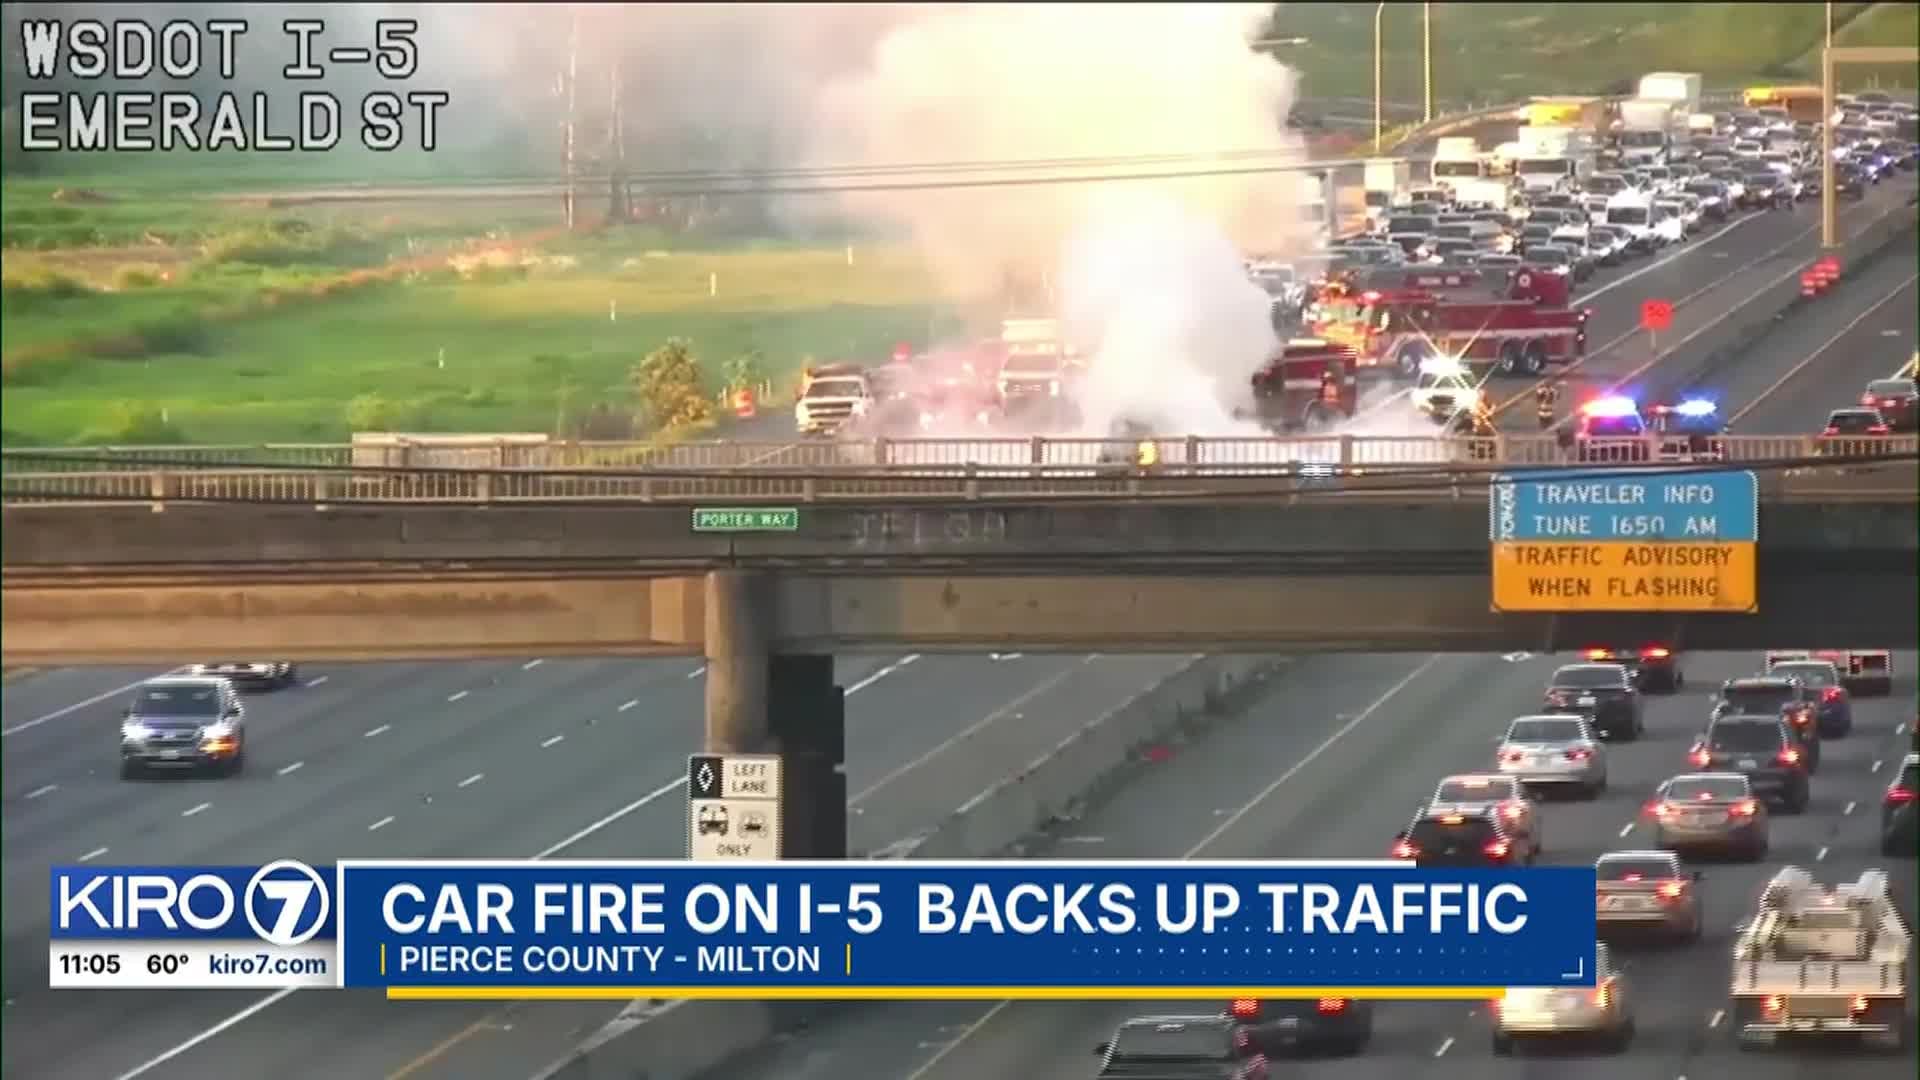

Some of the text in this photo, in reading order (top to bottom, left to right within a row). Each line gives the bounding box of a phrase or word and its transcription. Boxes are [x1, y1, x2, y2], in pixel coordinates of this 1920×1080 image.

[1535, 484, 1714, 505] TRAVELER INFO
[700, 512, 790, 528] PORTER WAY
[1534, 515, 1591, 535] TUNE
[1684, 515, 1717, 535] AM
[1514, 546, 1733, 566] TRAFFIC ADVISORY
[1528, 577, 1719, 597] WHEN FLASHING
